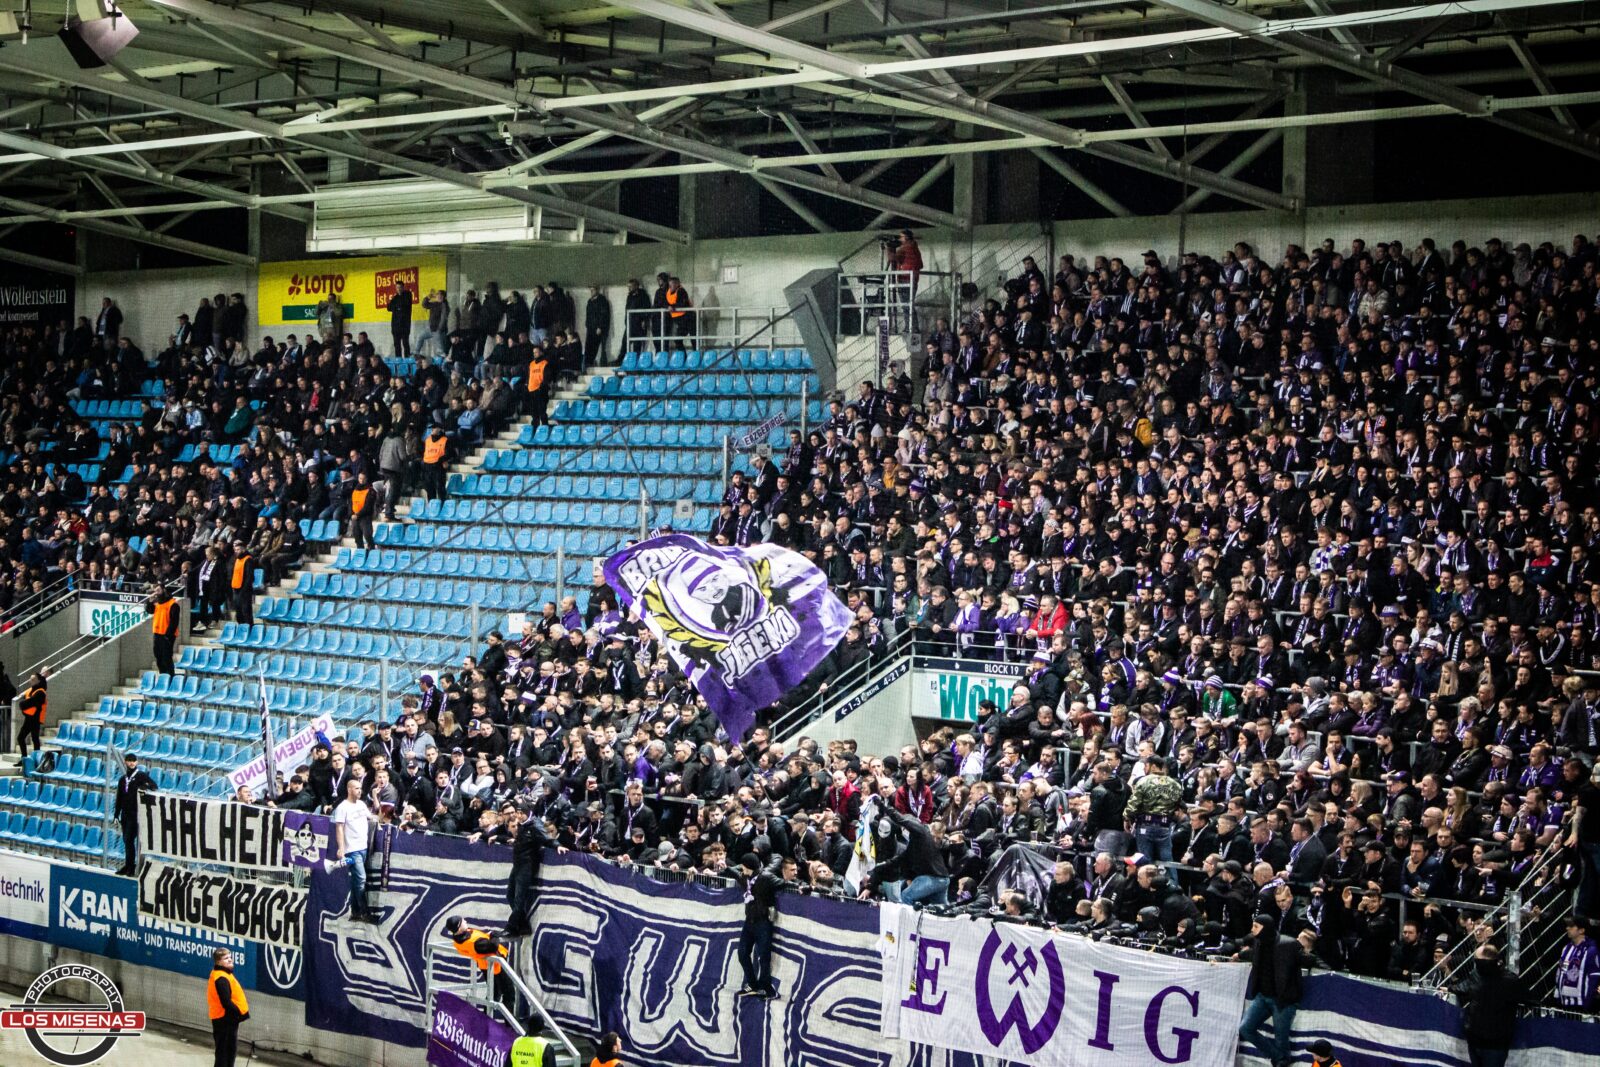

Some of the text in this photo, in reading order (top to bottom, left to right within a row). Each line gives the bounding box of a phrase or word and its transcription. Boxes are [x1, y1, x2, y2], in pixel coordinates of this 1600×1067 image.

[305, 274, 345, 294] LOTTO
[376, 270, 415, 288] Das Glück
[0, 285, 67, 306] Wöllenstein
[377, 292, 388, 306] ist
[744, 412, 785, 446] ERZGEBIRGE
[55, 600, 70, 612] 4-10
[119, 594, 132, 602] BLOCK
[984, 663, 1019, 675] BLOCK 19
[848, 697, 861, 711] 1-3
[883, 669, 900, 686] 4-21
[939, 674, 1014, 723] Woh
[140, 793, 290, 868] THALHEIM
[0, 875, 44, 903] technik
[59, 884, 128, 928] KRAN
[140, 860, 309, 947] LANGENBACH
[116, 926, 142, 944] KRAN-
[144, 933, 163, 950] UND
[901, 928, 1201, 1065] EWIG
